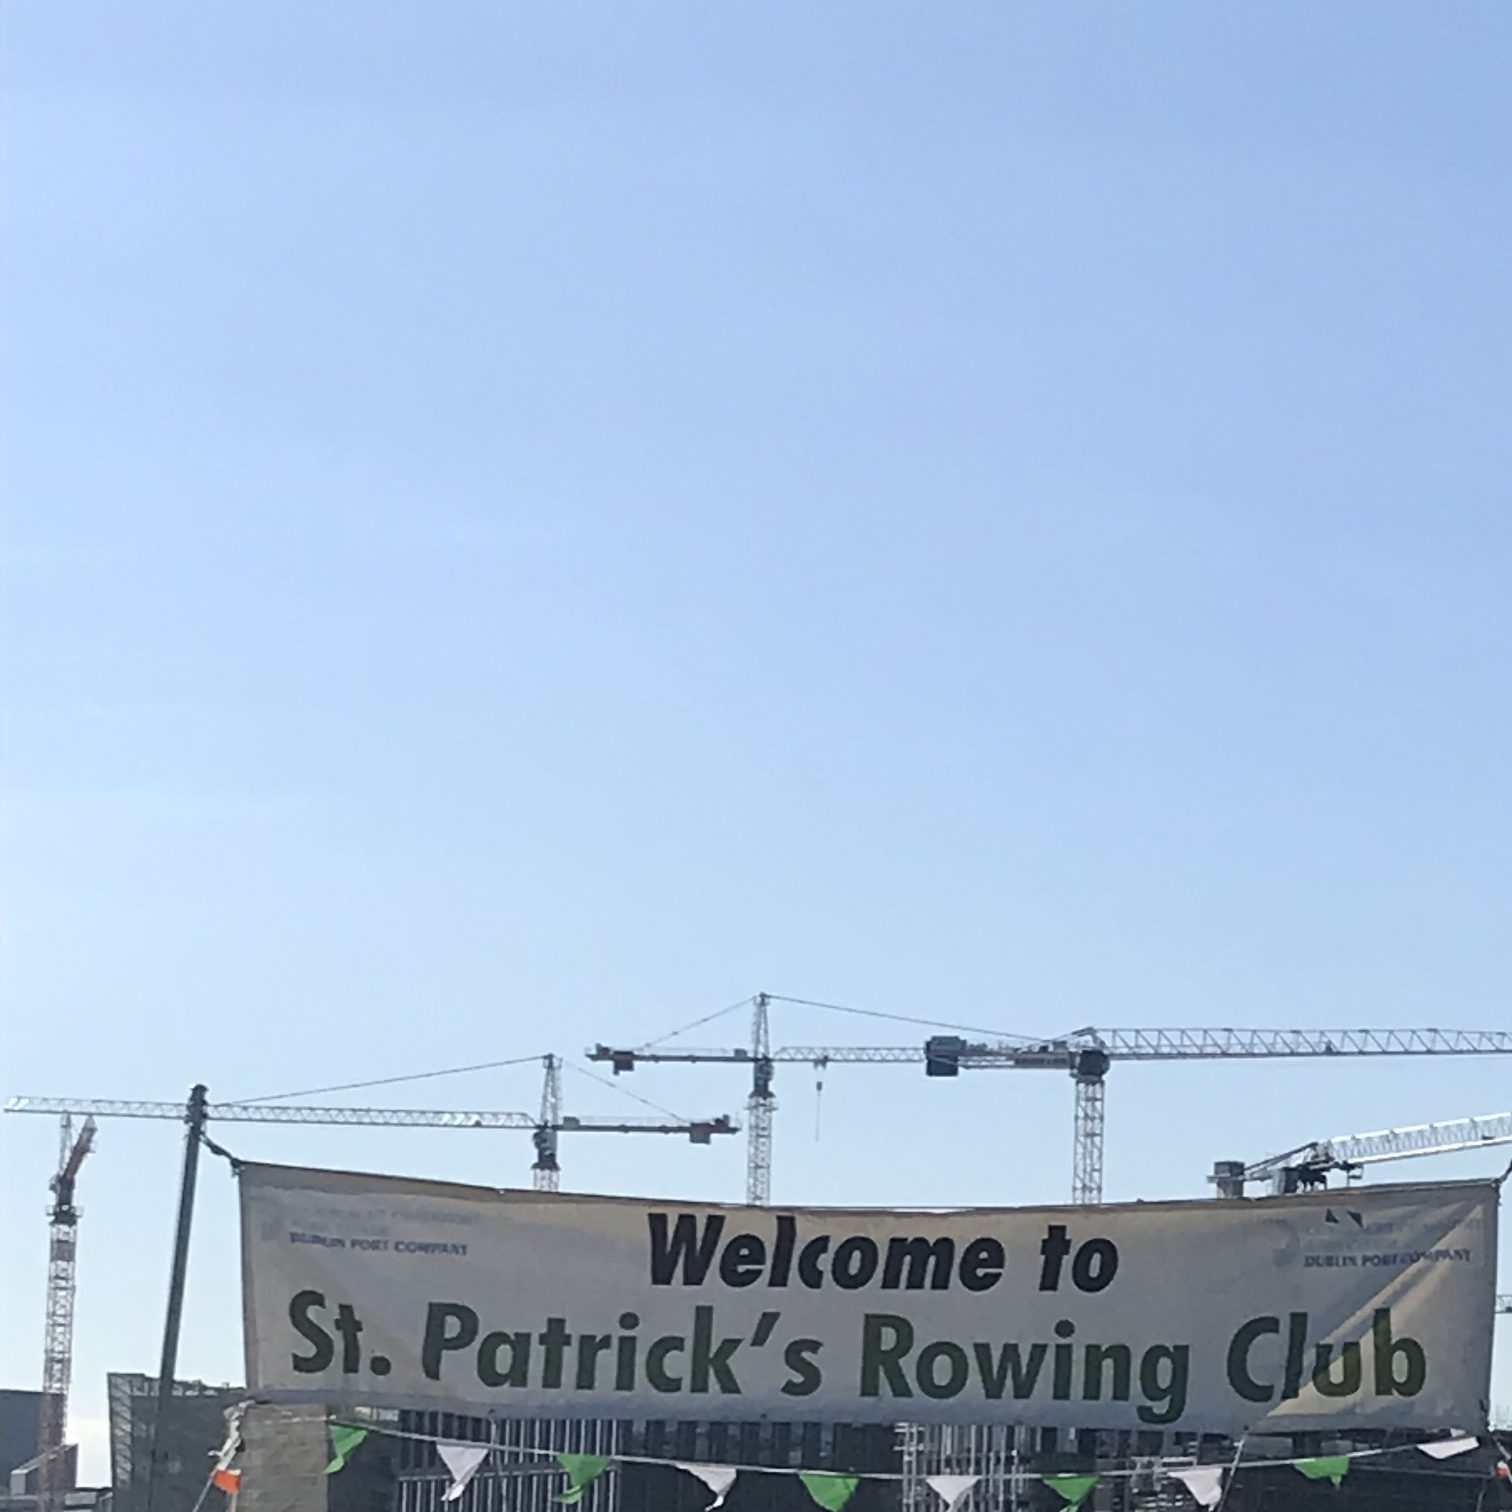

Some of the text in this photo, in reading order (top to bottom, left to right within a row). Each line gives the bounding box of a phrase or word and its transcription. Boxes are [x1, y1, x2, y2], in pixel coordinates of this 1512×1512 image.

[648, 1212, 1120, 1292] Welcome to
[1304, 1253, 1357, 1267] DUBLIN
[289, 1290, 1427, 1424] St. Patrick's Rowing Club
